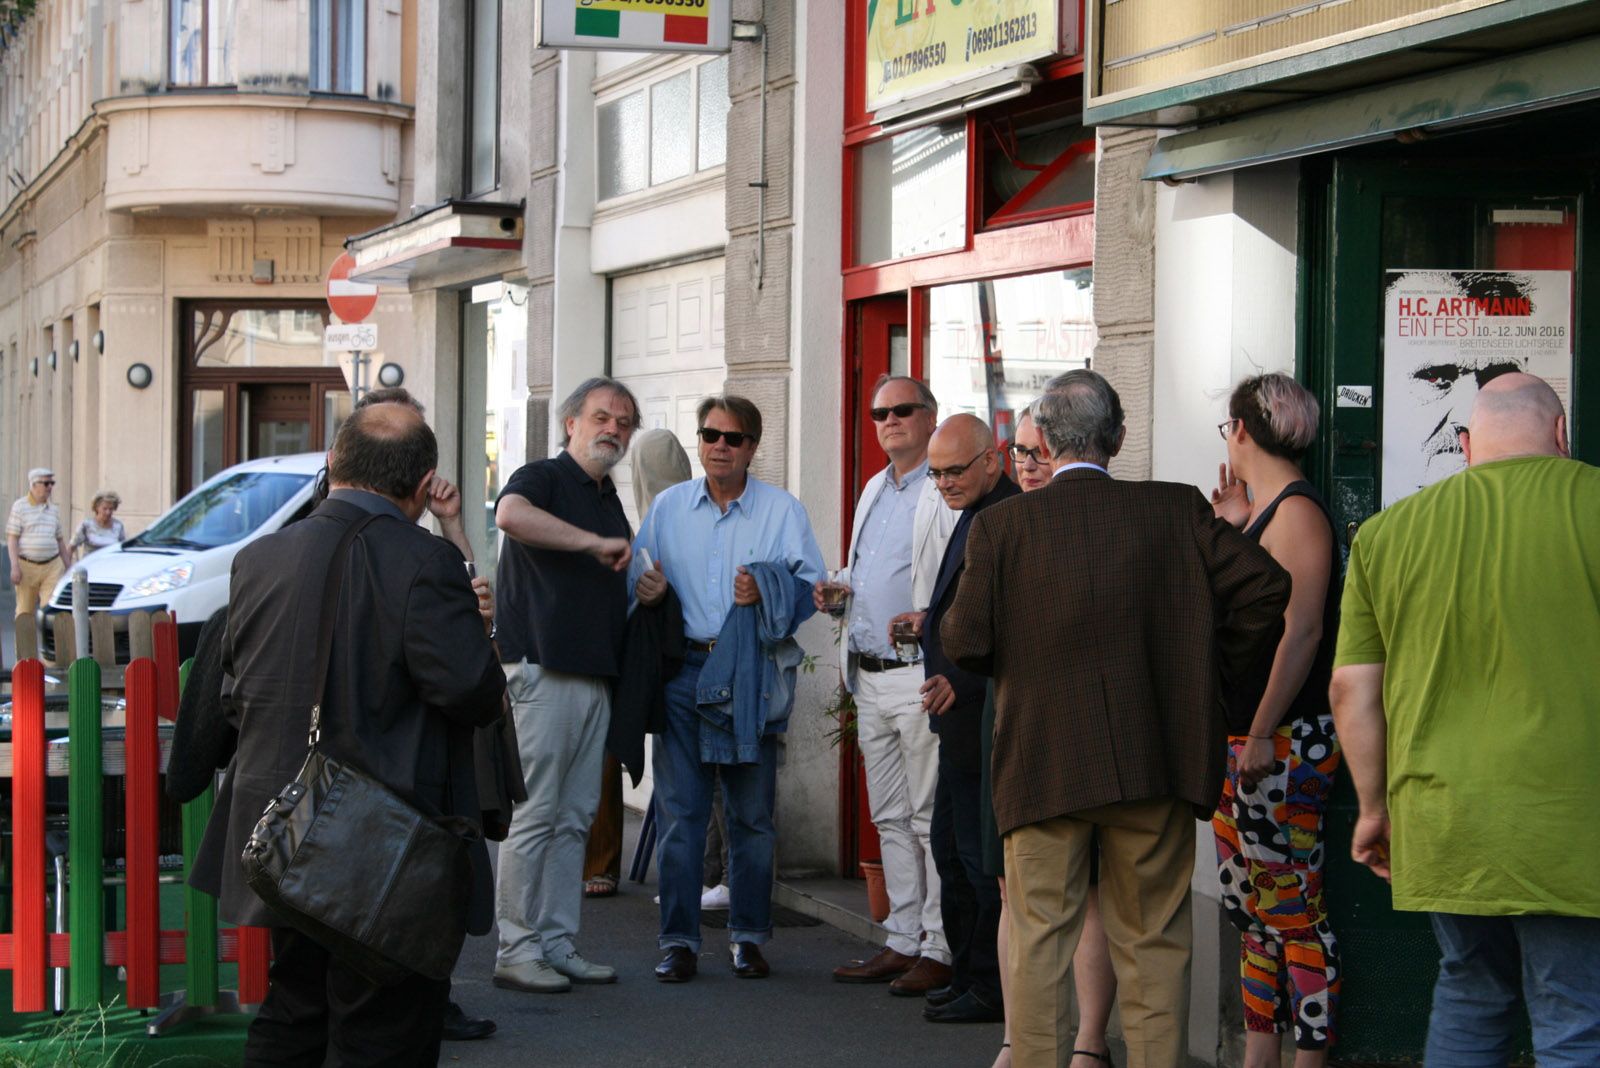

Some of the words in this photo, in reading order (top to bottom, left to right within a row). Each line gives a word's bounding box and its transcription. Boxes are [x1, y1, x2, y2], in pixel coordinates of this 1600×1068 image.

[972, 12, 1037, 55] 069911362813
[892, 41, 946, 79] 01/7896550
[1398, 297, 1432, 317] H.C.
[1436, 297, 1531, 317] ARTMANN
[1398, 317, 1427, 337] EIN
[1433, 317, 1480, 337] FEST
[1515, 326, 1537, 337] JUNI
[1539, 326, 1565, 337] 2016
[1459, 338, 1513, 349] BREITENSEER
[1515, 338, 1564, 349] LICHTSPIELE
